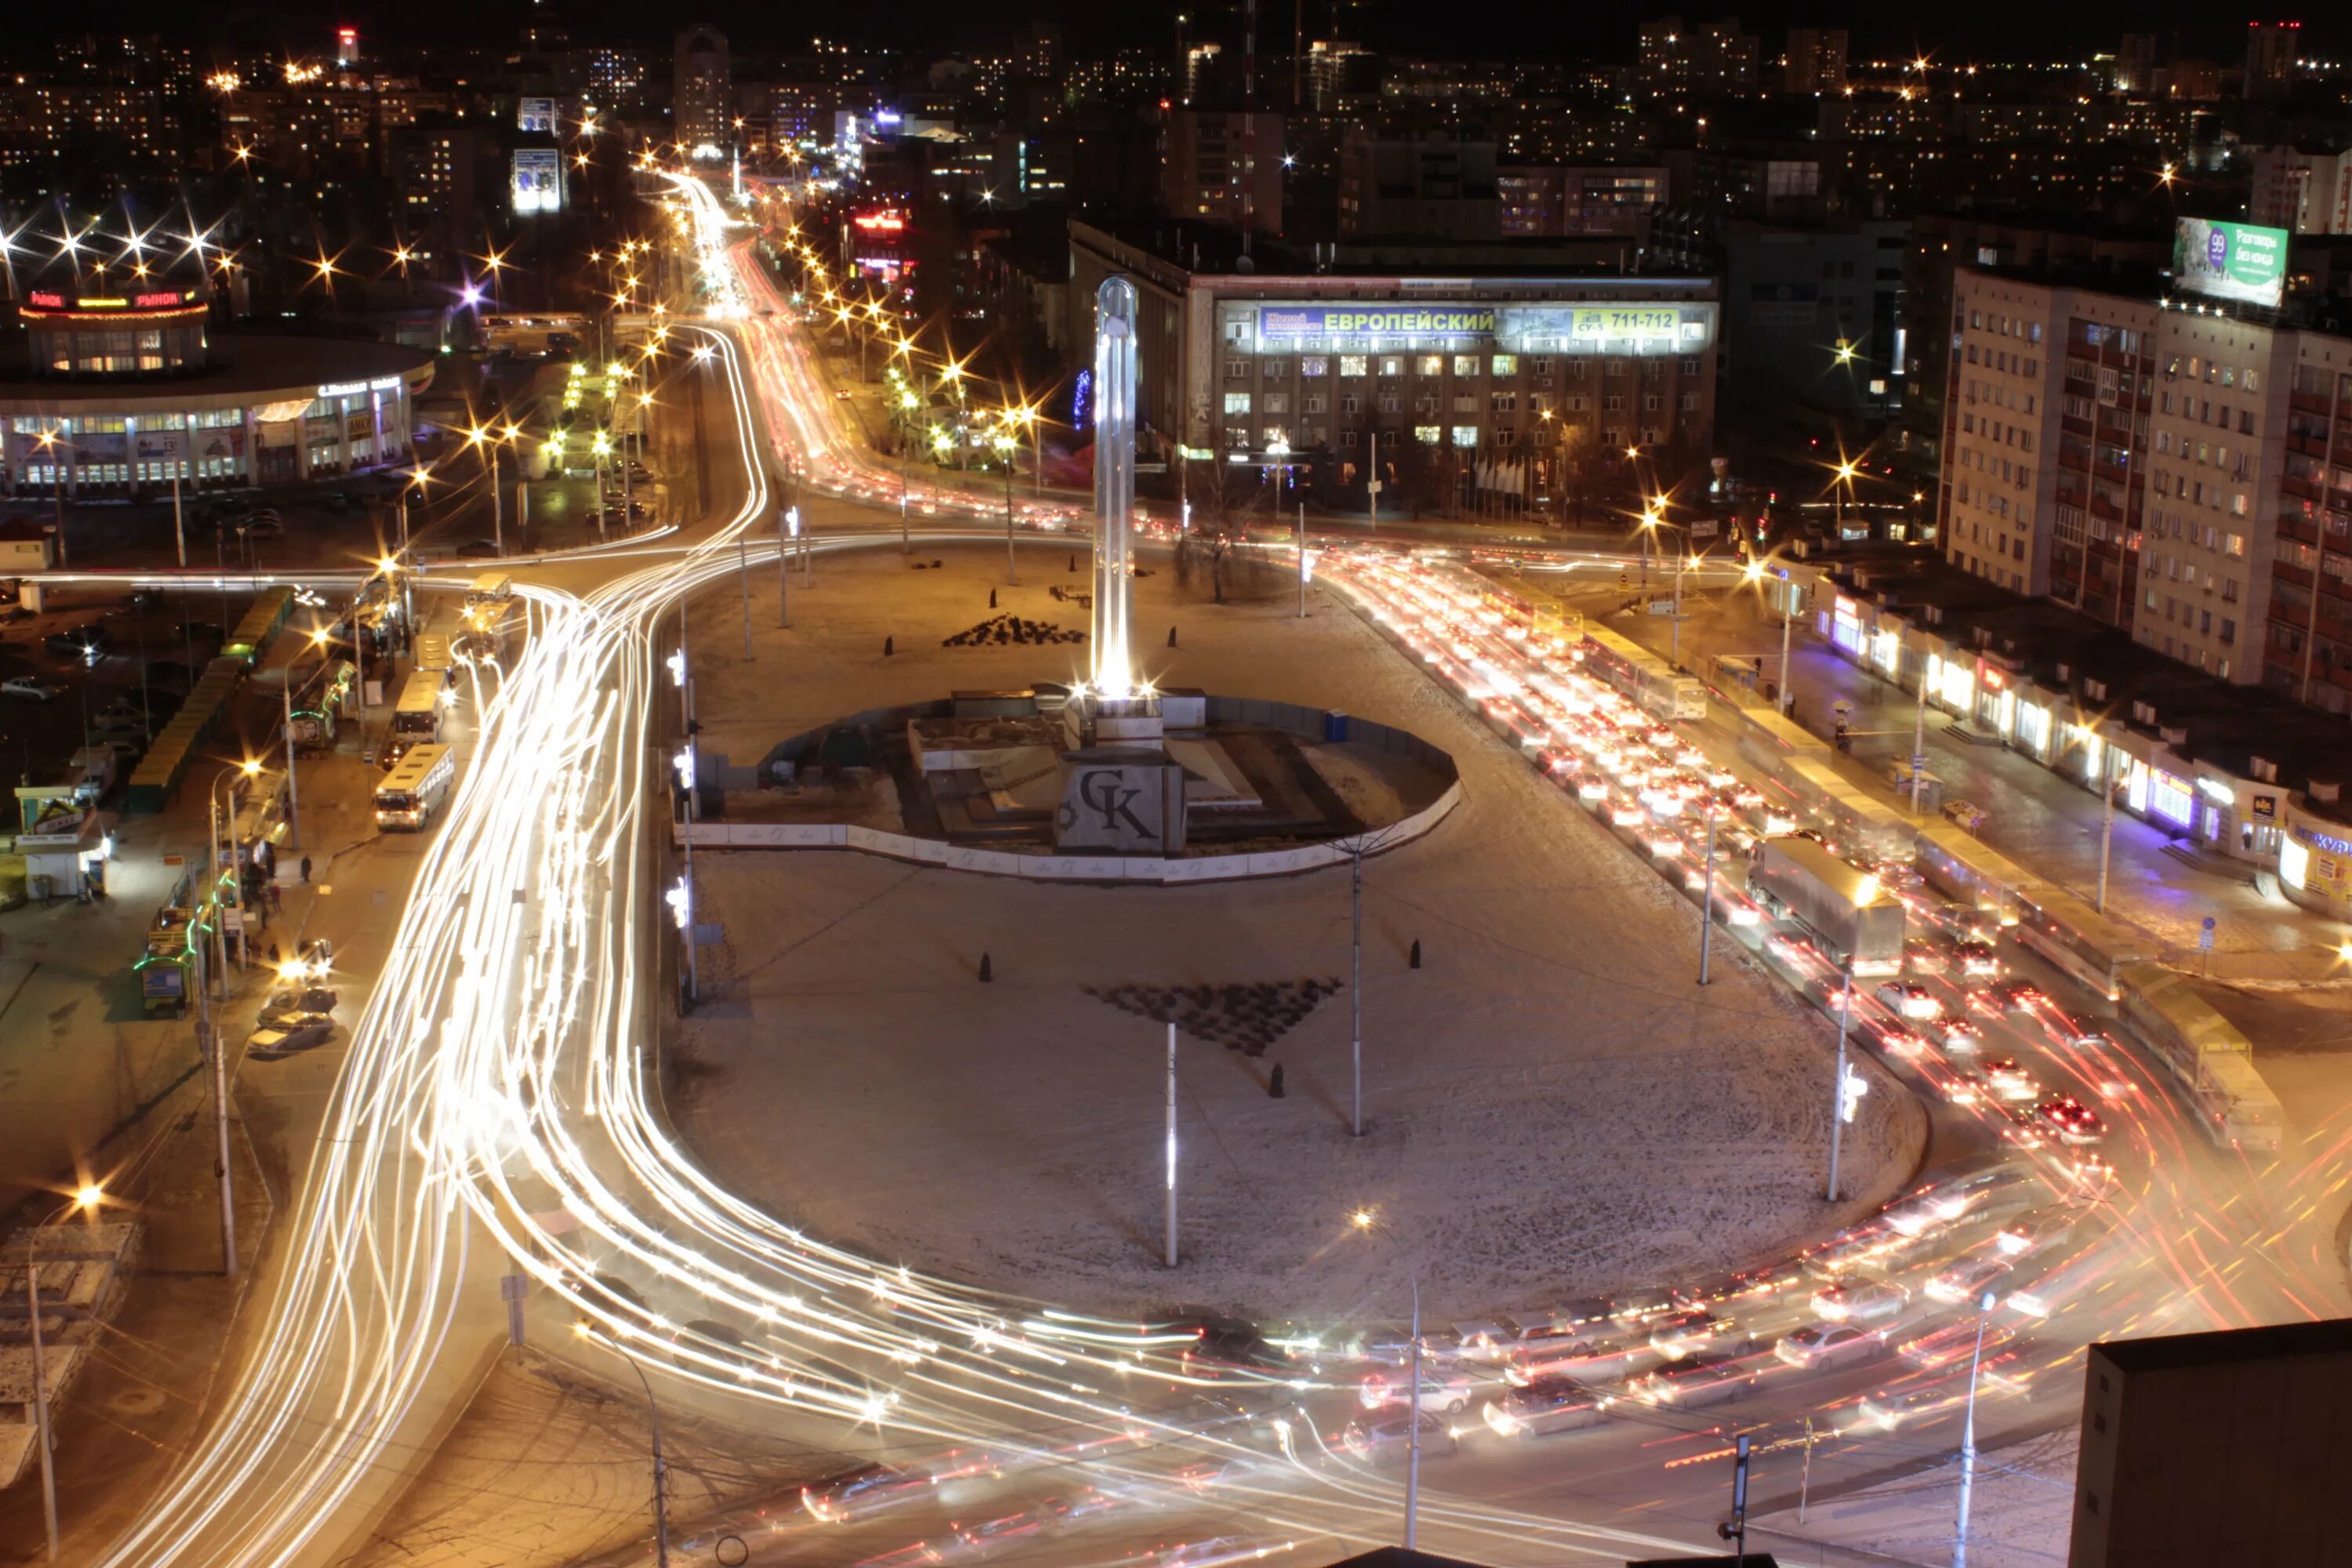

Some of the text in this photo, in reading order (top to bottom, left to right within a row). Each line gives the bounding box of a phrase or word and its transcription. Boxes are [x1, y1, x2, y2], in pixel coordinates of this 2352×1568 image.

[2212, 234, 2225, 252] 99
[31, 293, 63, 307] РЫНОК
[137, 293, 178, 306] РЫНОК
[1324, 310, 1494, 330] ЕВРОПЕЙСКИЙ
[1611, 314, 1672, 328] 711-712
